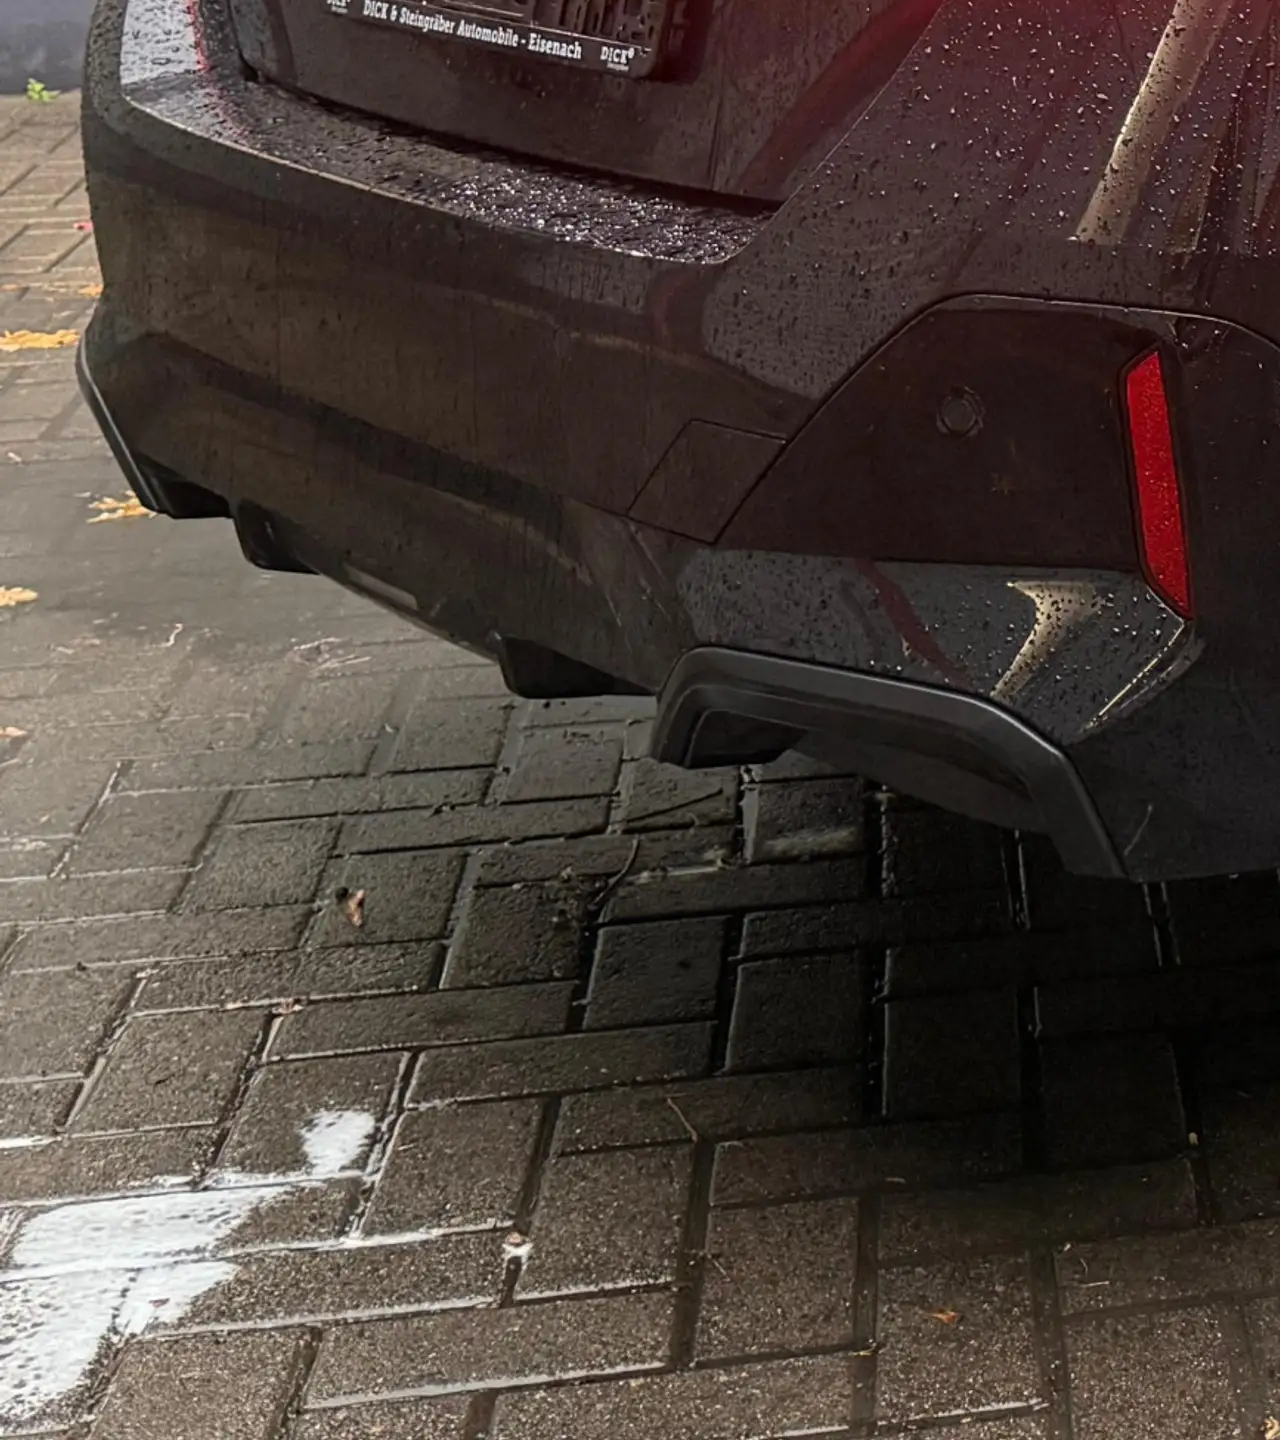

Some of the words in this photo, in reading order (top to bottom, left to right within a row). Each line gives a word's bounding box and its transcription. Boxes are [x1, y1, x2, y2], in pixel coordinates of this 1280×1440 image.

[363, 0, 389, 20] DICK
[399, 7, 456, 33] Steingräber
[456, 19, 519, 48] Automobile
[528, 32, 582, 60] Eisenach
